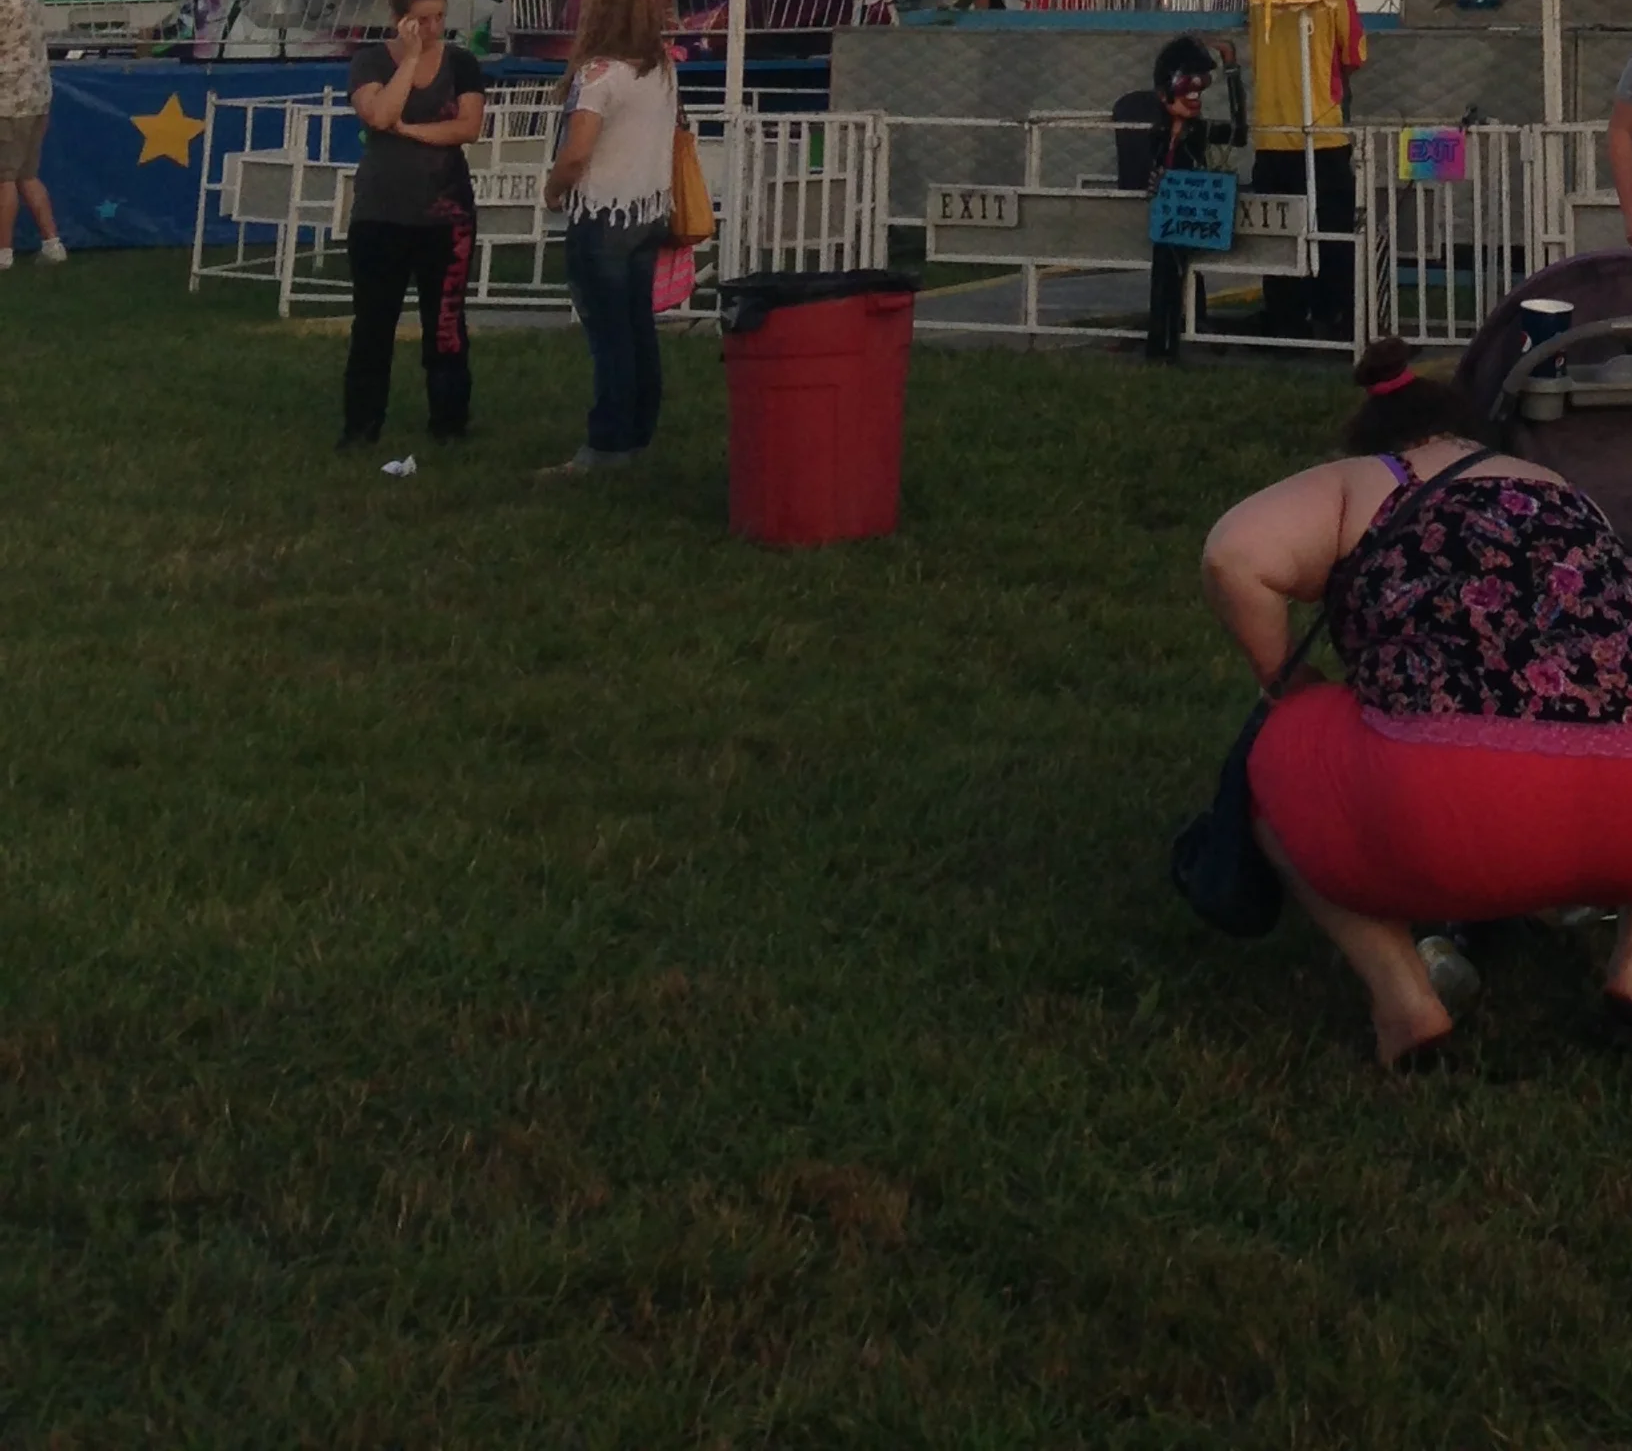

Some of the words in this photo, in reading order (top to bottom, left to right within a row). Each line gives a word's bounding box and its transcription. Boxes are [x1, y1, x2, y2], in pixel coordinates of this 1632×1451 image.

[1407, 138, 1460, 163] EXIT
[940, 192, 1008, 220] EXIT
[1239, 200, 1291, 230] XIT
[1160, 218, 1223, 239] ZIPPER
